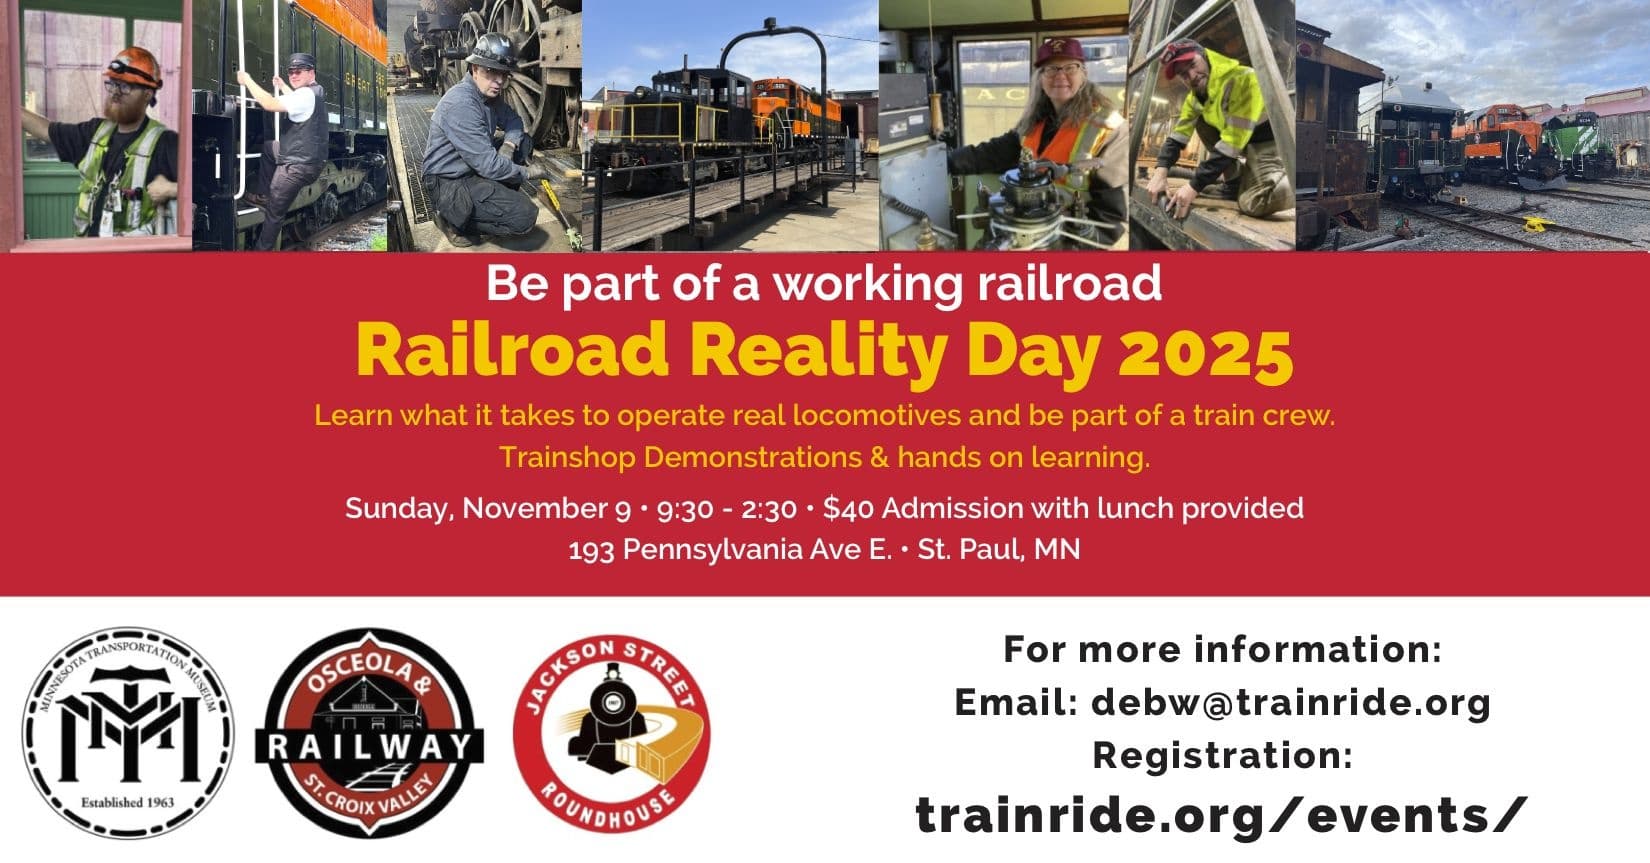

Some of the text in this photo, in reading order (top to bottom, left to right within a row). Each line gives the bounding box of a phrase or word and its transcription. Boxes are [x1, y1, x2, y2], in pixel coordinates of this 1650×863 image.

[488, 263, 1162, 311] Be part of a working railroad
[359, 320, 1293, 393] Railroad Reality Day 2025
[316, 404, 1334, 431] Learn what it takes to operate real locomotives and be part of a train crew.
[500, 446, 1149, 473] Trainshop Demonstrations & hands on learning.
[346, 496, 453, 525] Sunday,
[464, 496, 608, 518] November
[615, 501, 631, 523] 9
[658, 501, 713, 523] 9:30
[742, 501, 796, 522] 2:30
[824, 494, 874, 522] $40
[882, 496, 1023, 518] Admission
[1031, 497, 1088, 518] with
[1099, 496, 1173, 518] lunch
[1183, 496, 1304, 524] provided
[570, 537, 1079, 566] 193 Pennsylvania Ave E. St. Paul, MN
[1005, 634, 1439, 662] For more information:
[39, 642, 217, 713] MINNESOTA TRANSPORTATION MUSEUM
[307, 652, 432, 695] OSCEOLA &
[526, 640, 695, 716] JACKSON STREET
[957, 688, 1489, 723] Email: debw@trainride.org
[268, 734, 471, 760] RAILWAY
[1095, 741, 1350, 776] Registration:
[81, 797, 175, 809] Established 1963
[304, 773, 433, 815] ST. CROIX VALLEY
[541, 781, 675, 829] ROUNDHOUSE
[916, 795, 1528, 843] trainride.org/events/
